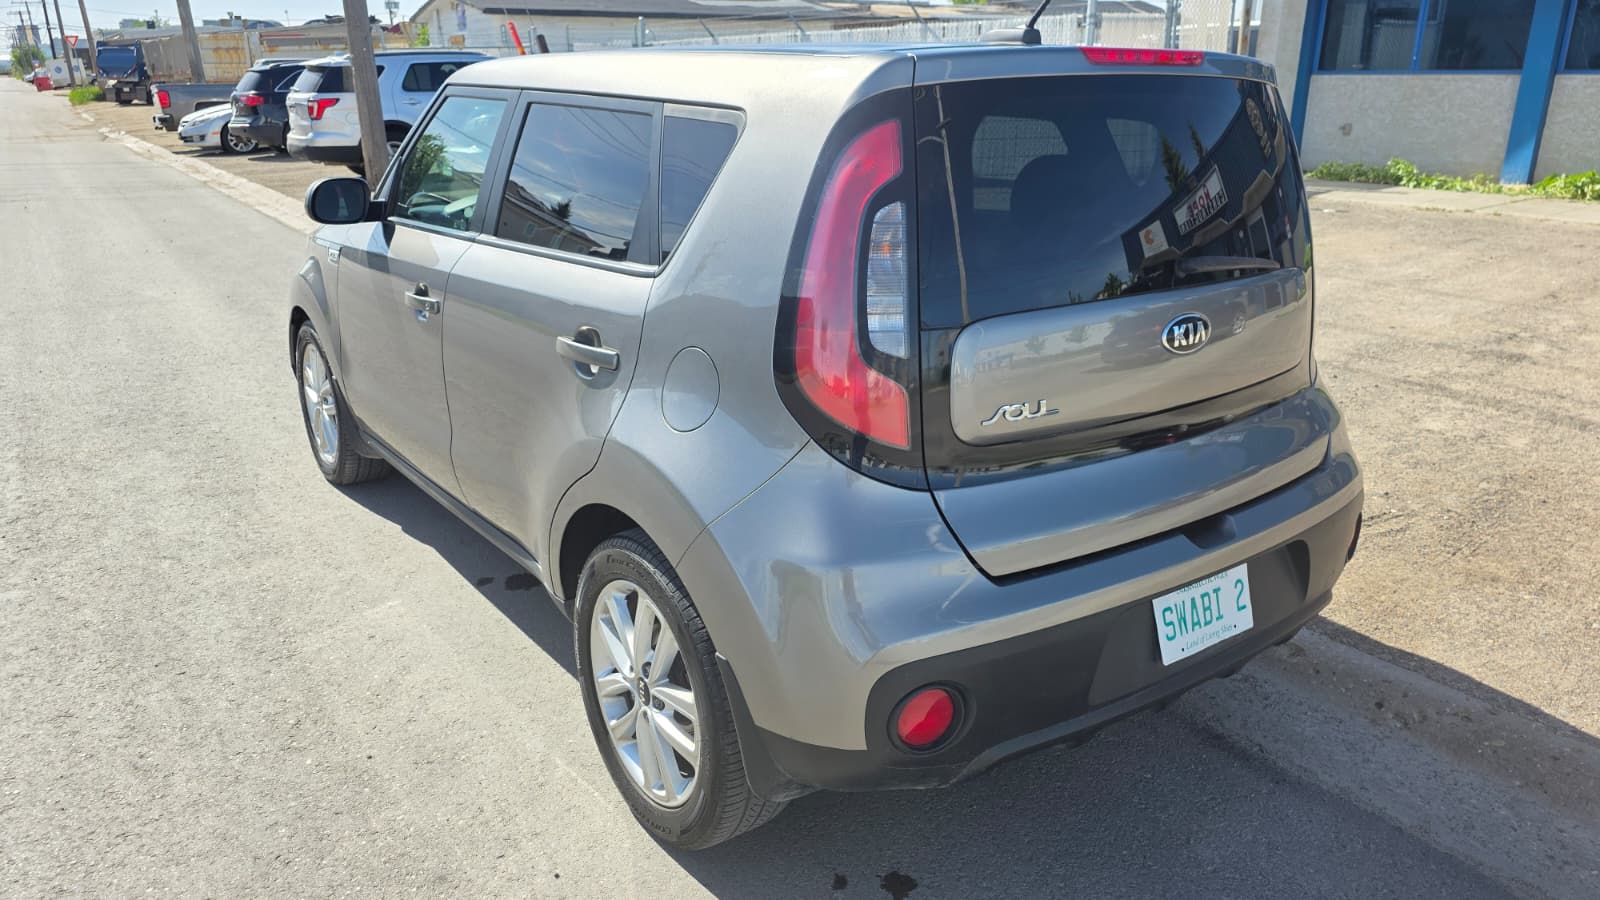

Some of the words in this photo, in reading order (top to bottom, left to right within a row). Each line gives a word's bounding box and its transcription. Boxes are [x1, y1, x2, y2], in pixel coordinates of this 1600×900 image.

[1172, 320, 1206, 348] KIA
[980, 399, 1060, 427] SOUL
[1161, 586, 1225, 642] SWABI
[1233, 578, 1248, 612] 2
